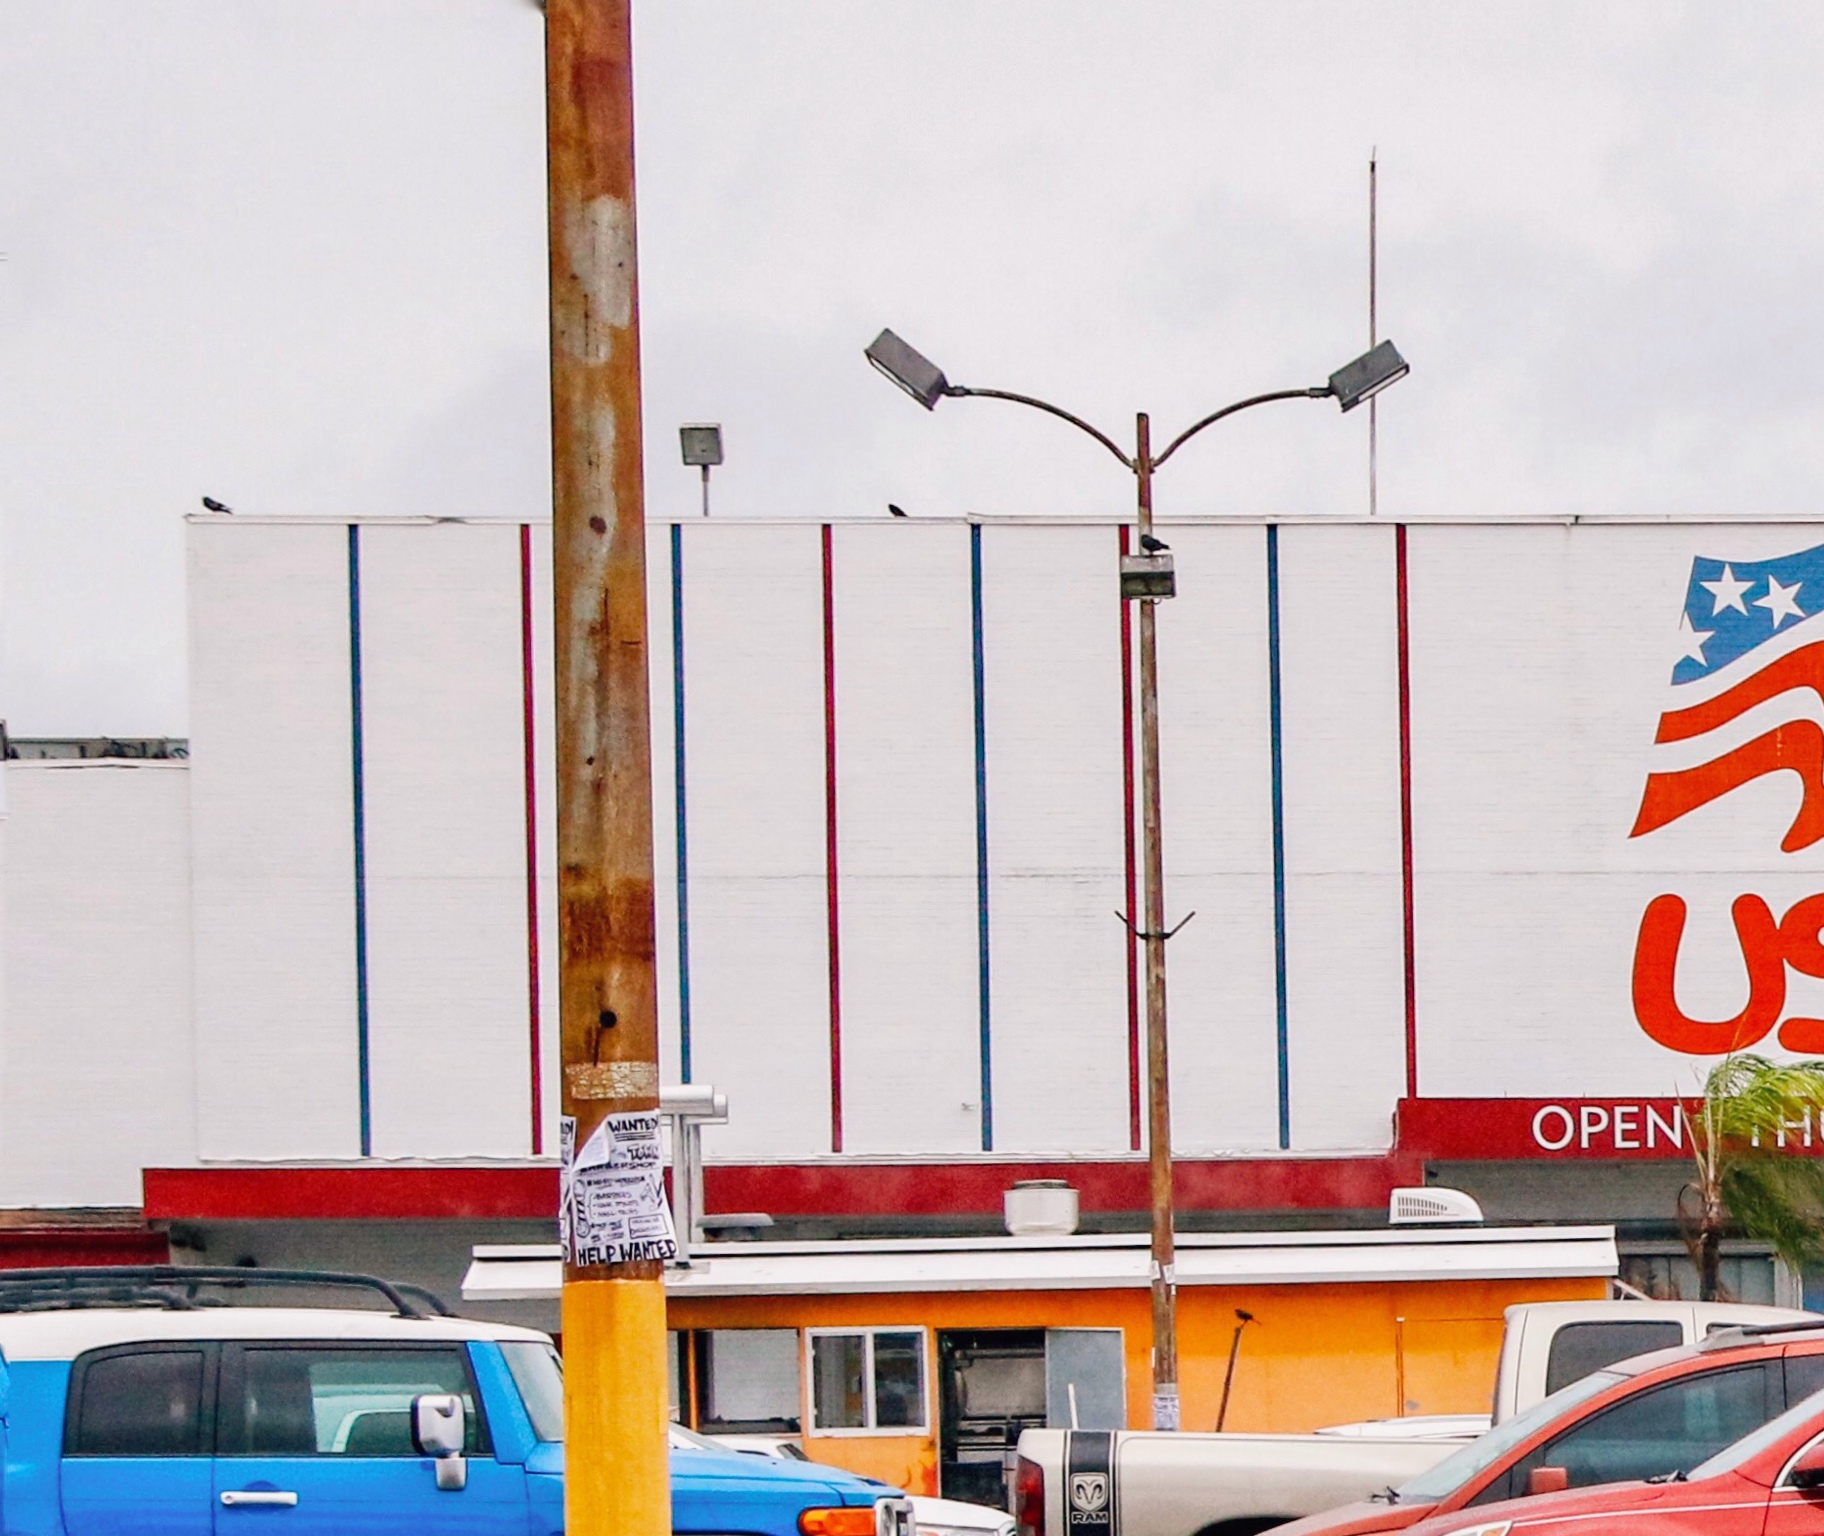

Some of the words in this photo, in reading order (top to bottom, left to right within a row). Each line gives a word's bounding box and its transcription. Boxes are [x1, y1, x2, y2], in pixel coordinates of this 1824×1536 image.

[608, 1118, 658, 1133] WANTED
[1531, 1104, 1683, 1151] OPEN
[577, 1244, 616, 1267] HELP
[619, 1239, 677, 1262] WANTED
[1072, 1511, 1109, 1524] RAM
